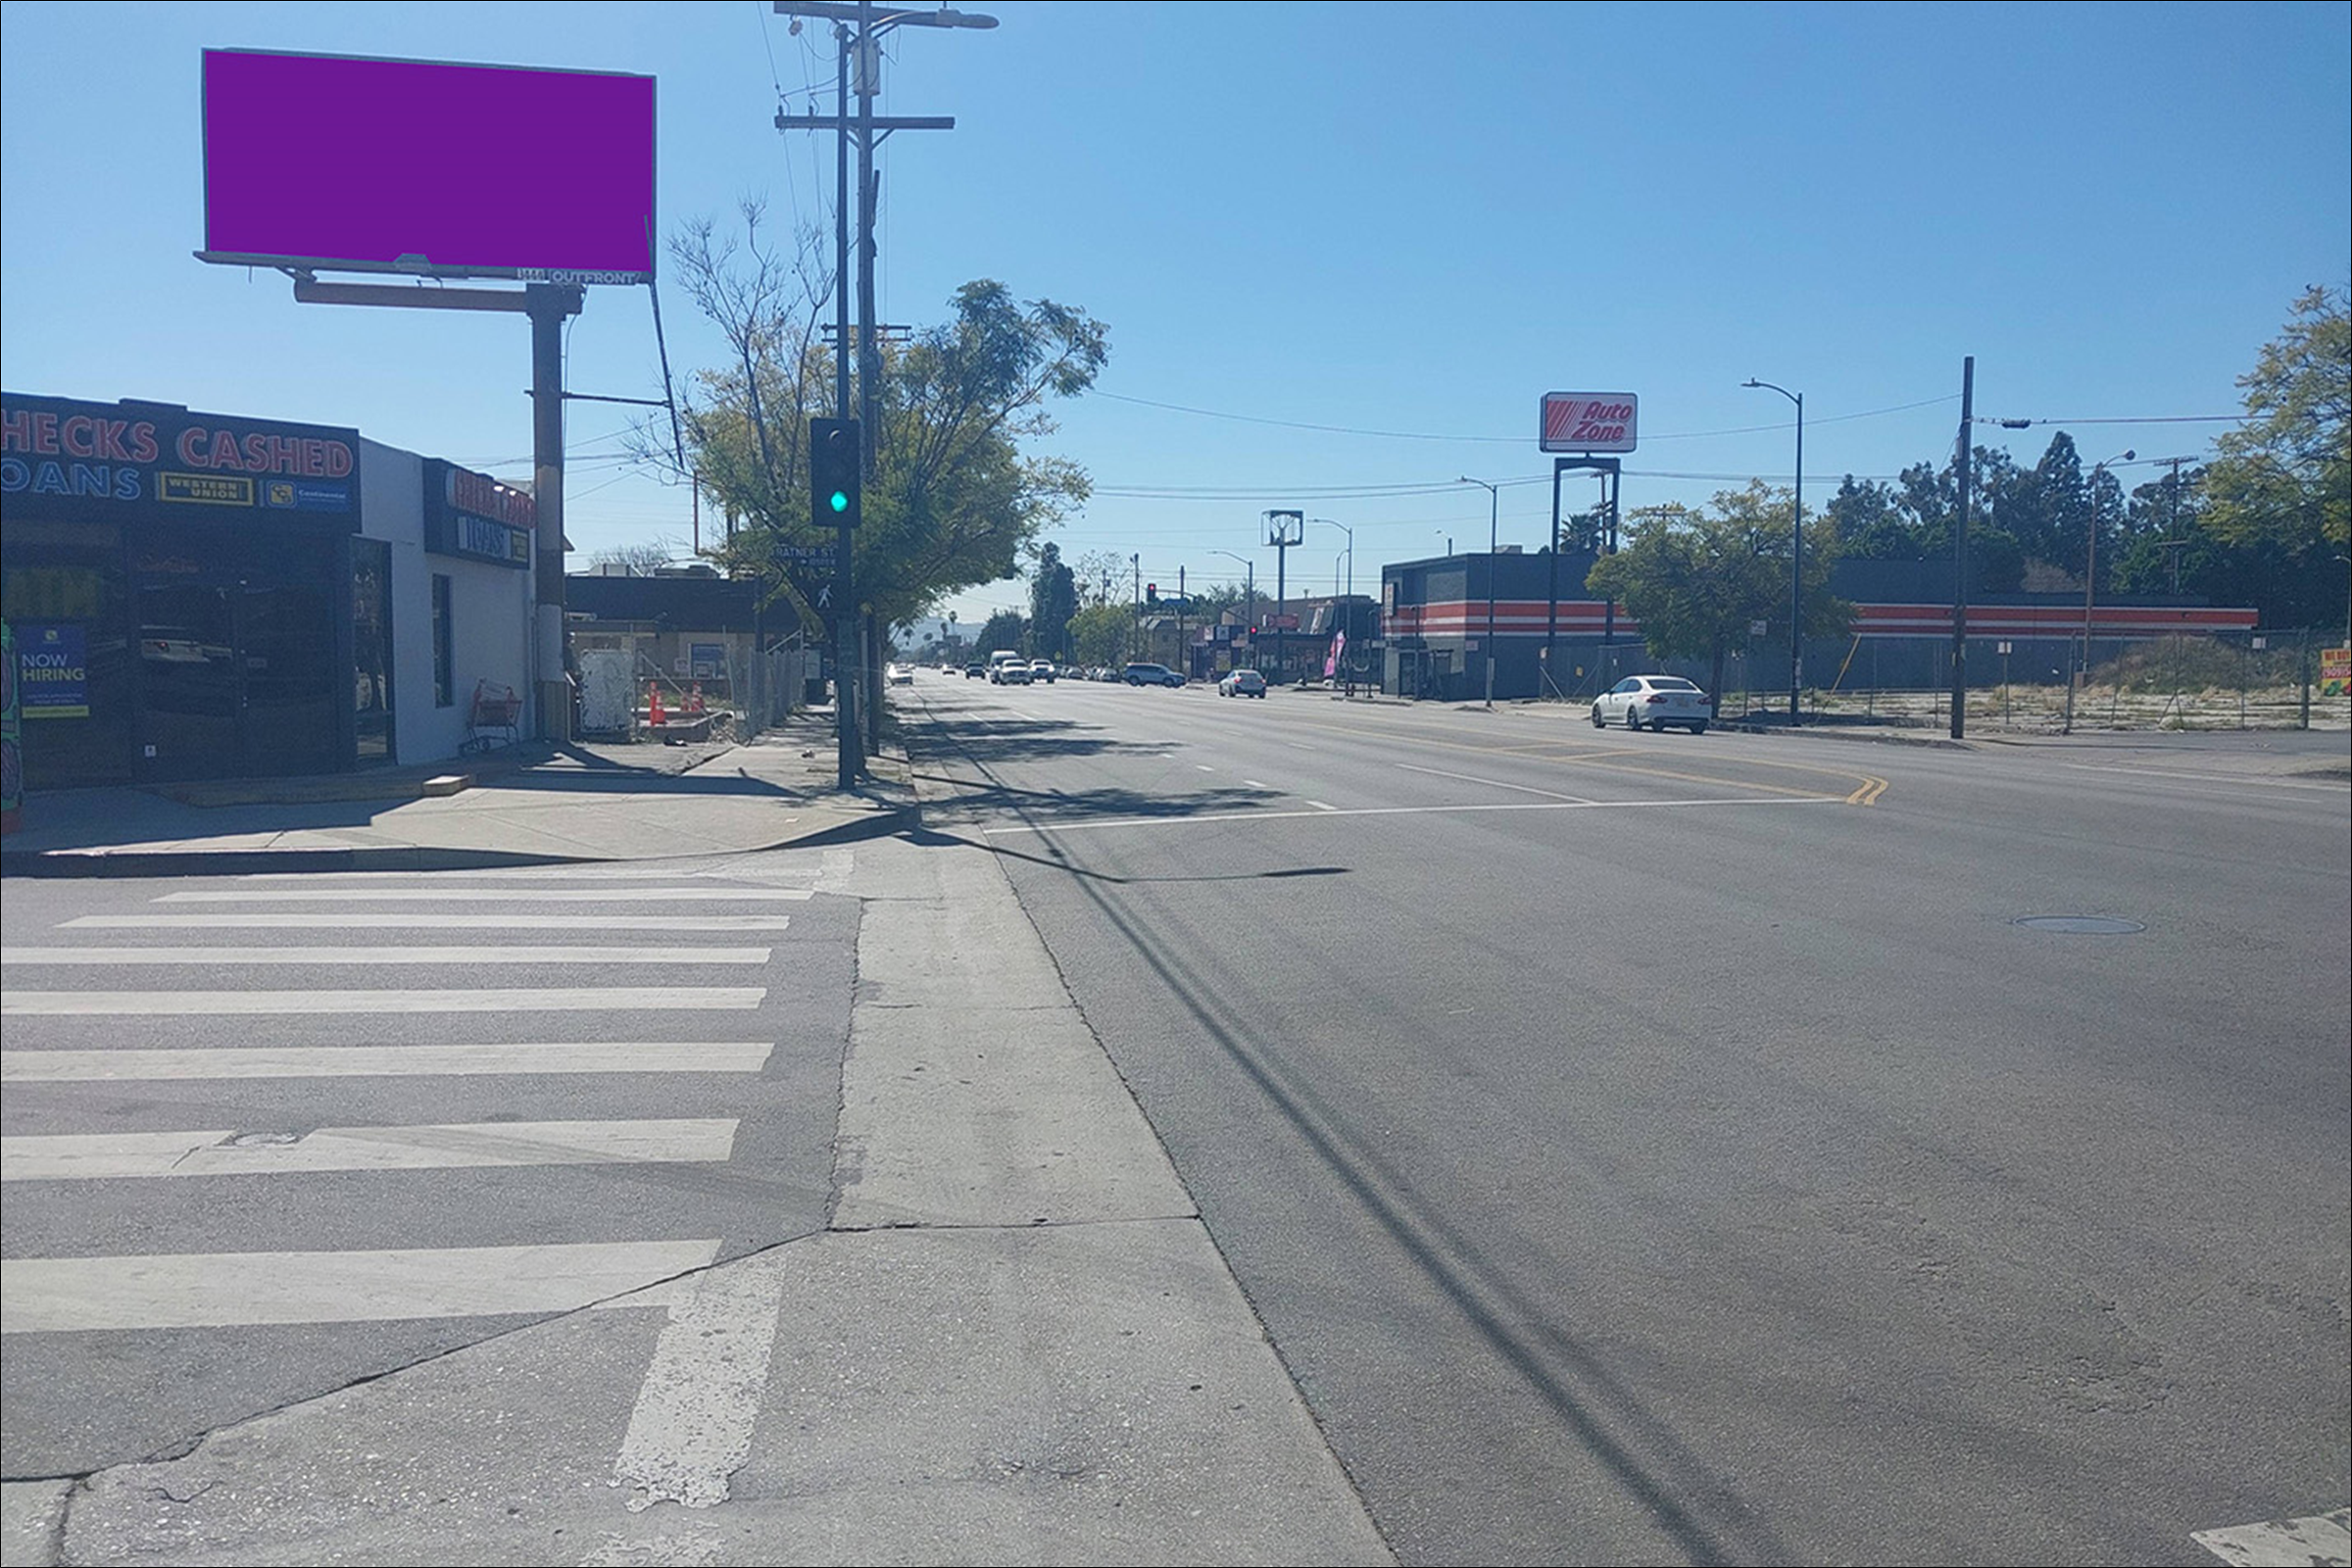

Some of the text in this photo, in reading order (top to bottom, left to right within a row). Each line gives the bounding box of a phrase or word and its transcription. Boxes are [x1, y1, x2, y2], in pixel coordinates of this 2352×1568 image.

[552, 270, 636, 284] OUTFRONT
[1582, 400, 1633, 420] Auto
[1570, 420, 1626, 441] Zone
[1, 408, 354, 477] HECKS CASHED
[168, 477, 237, 490] WESTERN
[190, 488, 238, 499] UNION
[22, 653, 68, 667] NOW
[22, 667, 85, 681] HIRING
